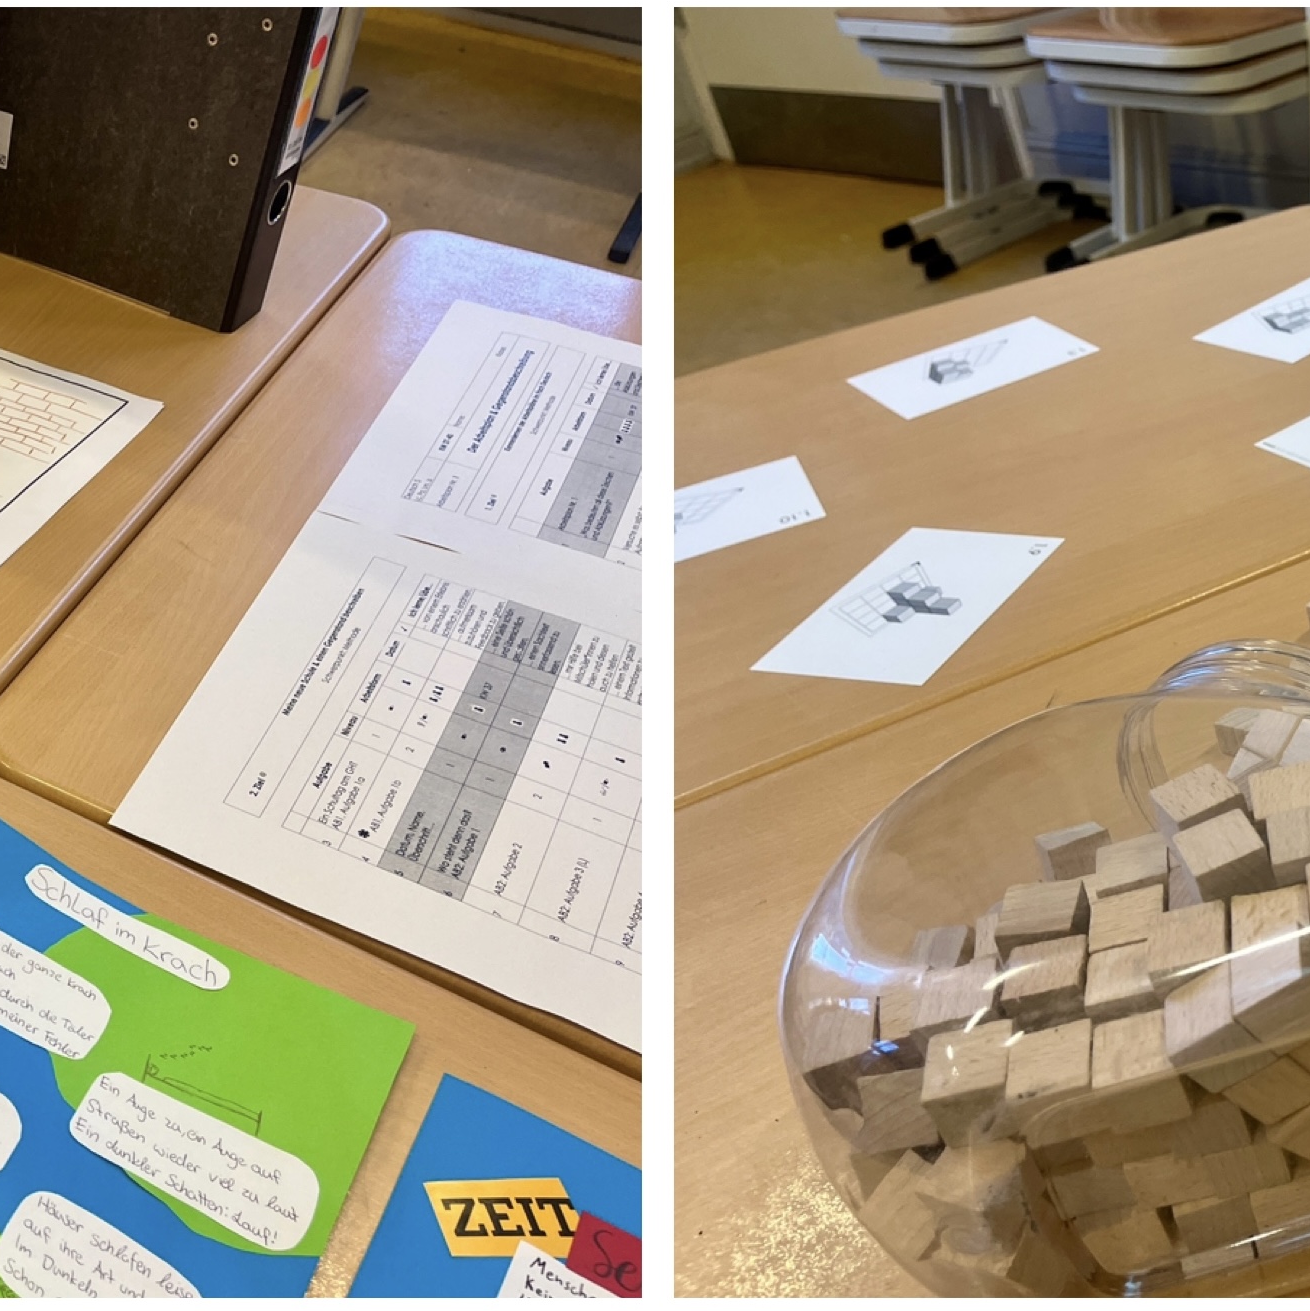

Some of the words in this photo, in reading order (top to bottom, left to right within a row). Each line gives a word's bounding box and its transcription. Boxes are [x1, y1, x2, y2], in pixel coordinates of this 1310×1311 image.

[114, 920, 139, 945] im
[142, 935, 218, 985] Krach
[441, 1197, 575, 1237] ZEIT
